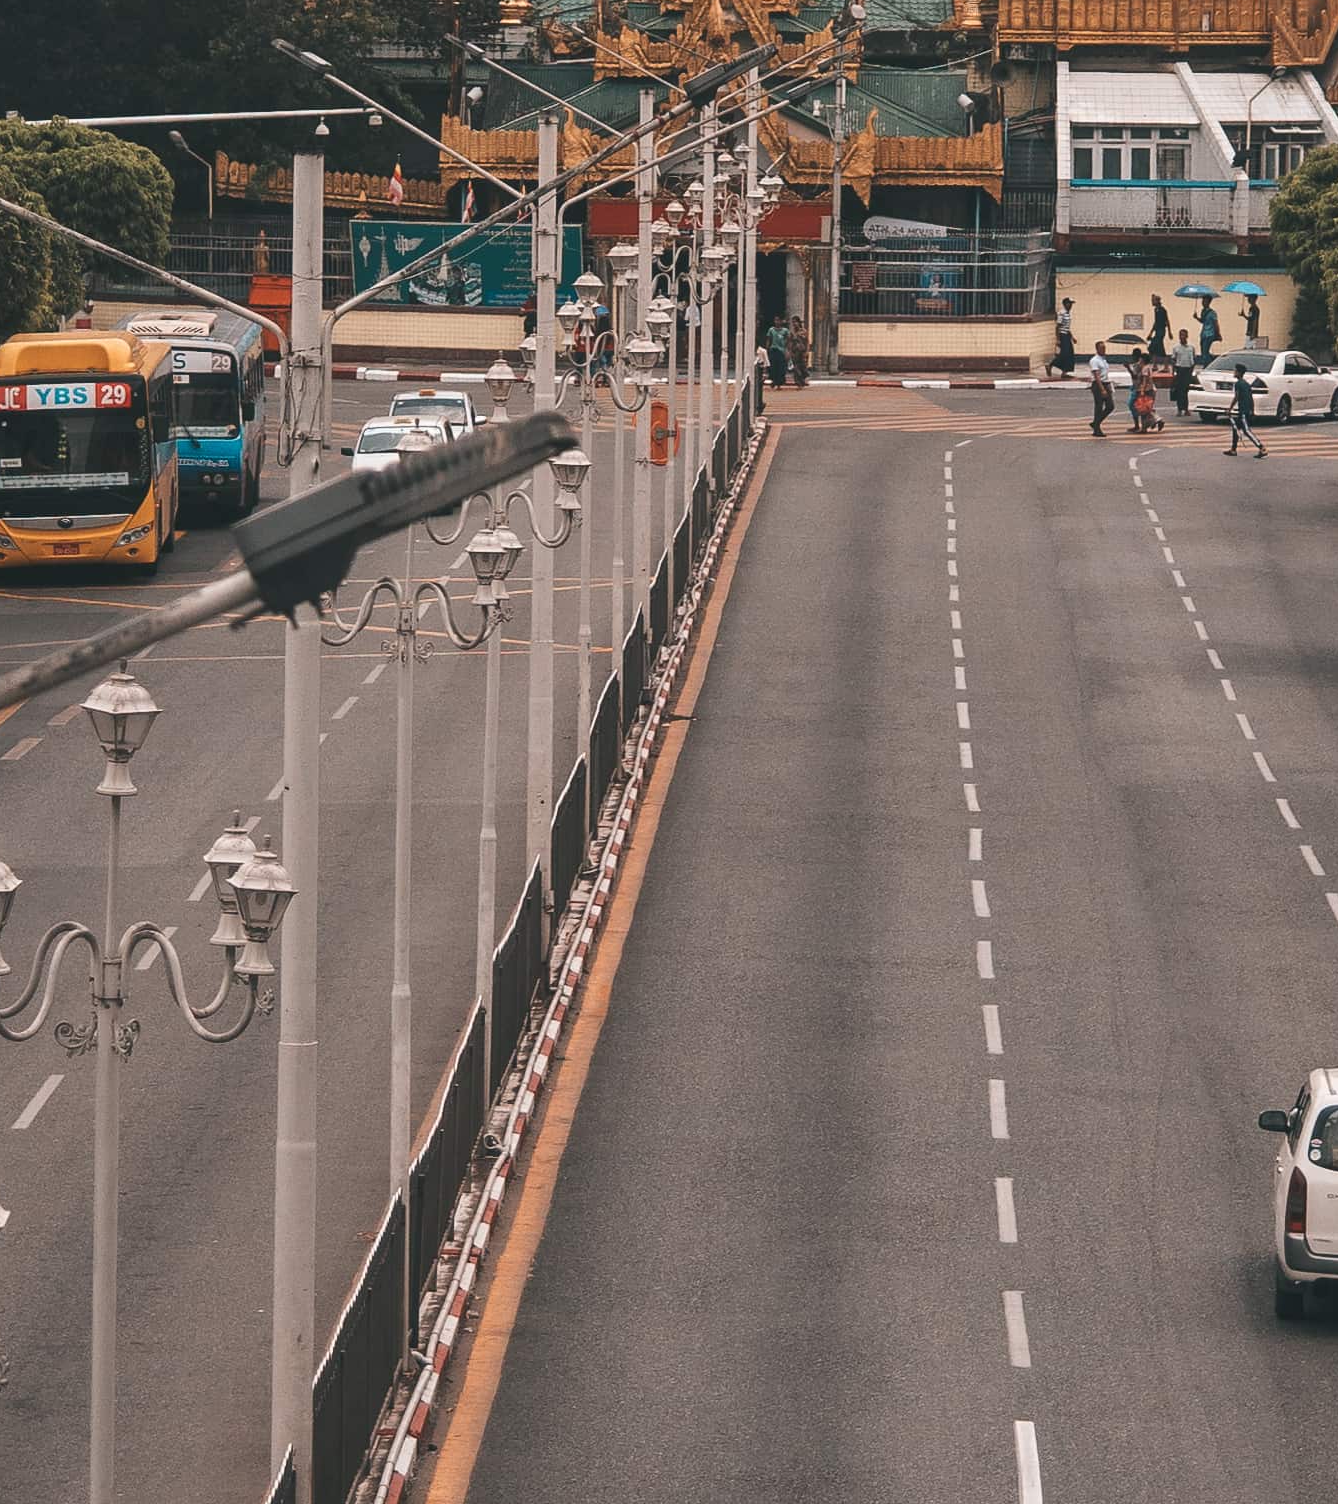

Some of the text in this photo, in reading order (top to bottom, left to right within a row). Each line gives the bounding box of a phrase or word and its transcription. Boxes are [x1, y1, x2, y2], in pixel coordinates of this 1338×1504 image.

[212, 355, 231, 370] 29
[35, 386, 88, 406] YBS
[100, 385, 126, 405] 29
